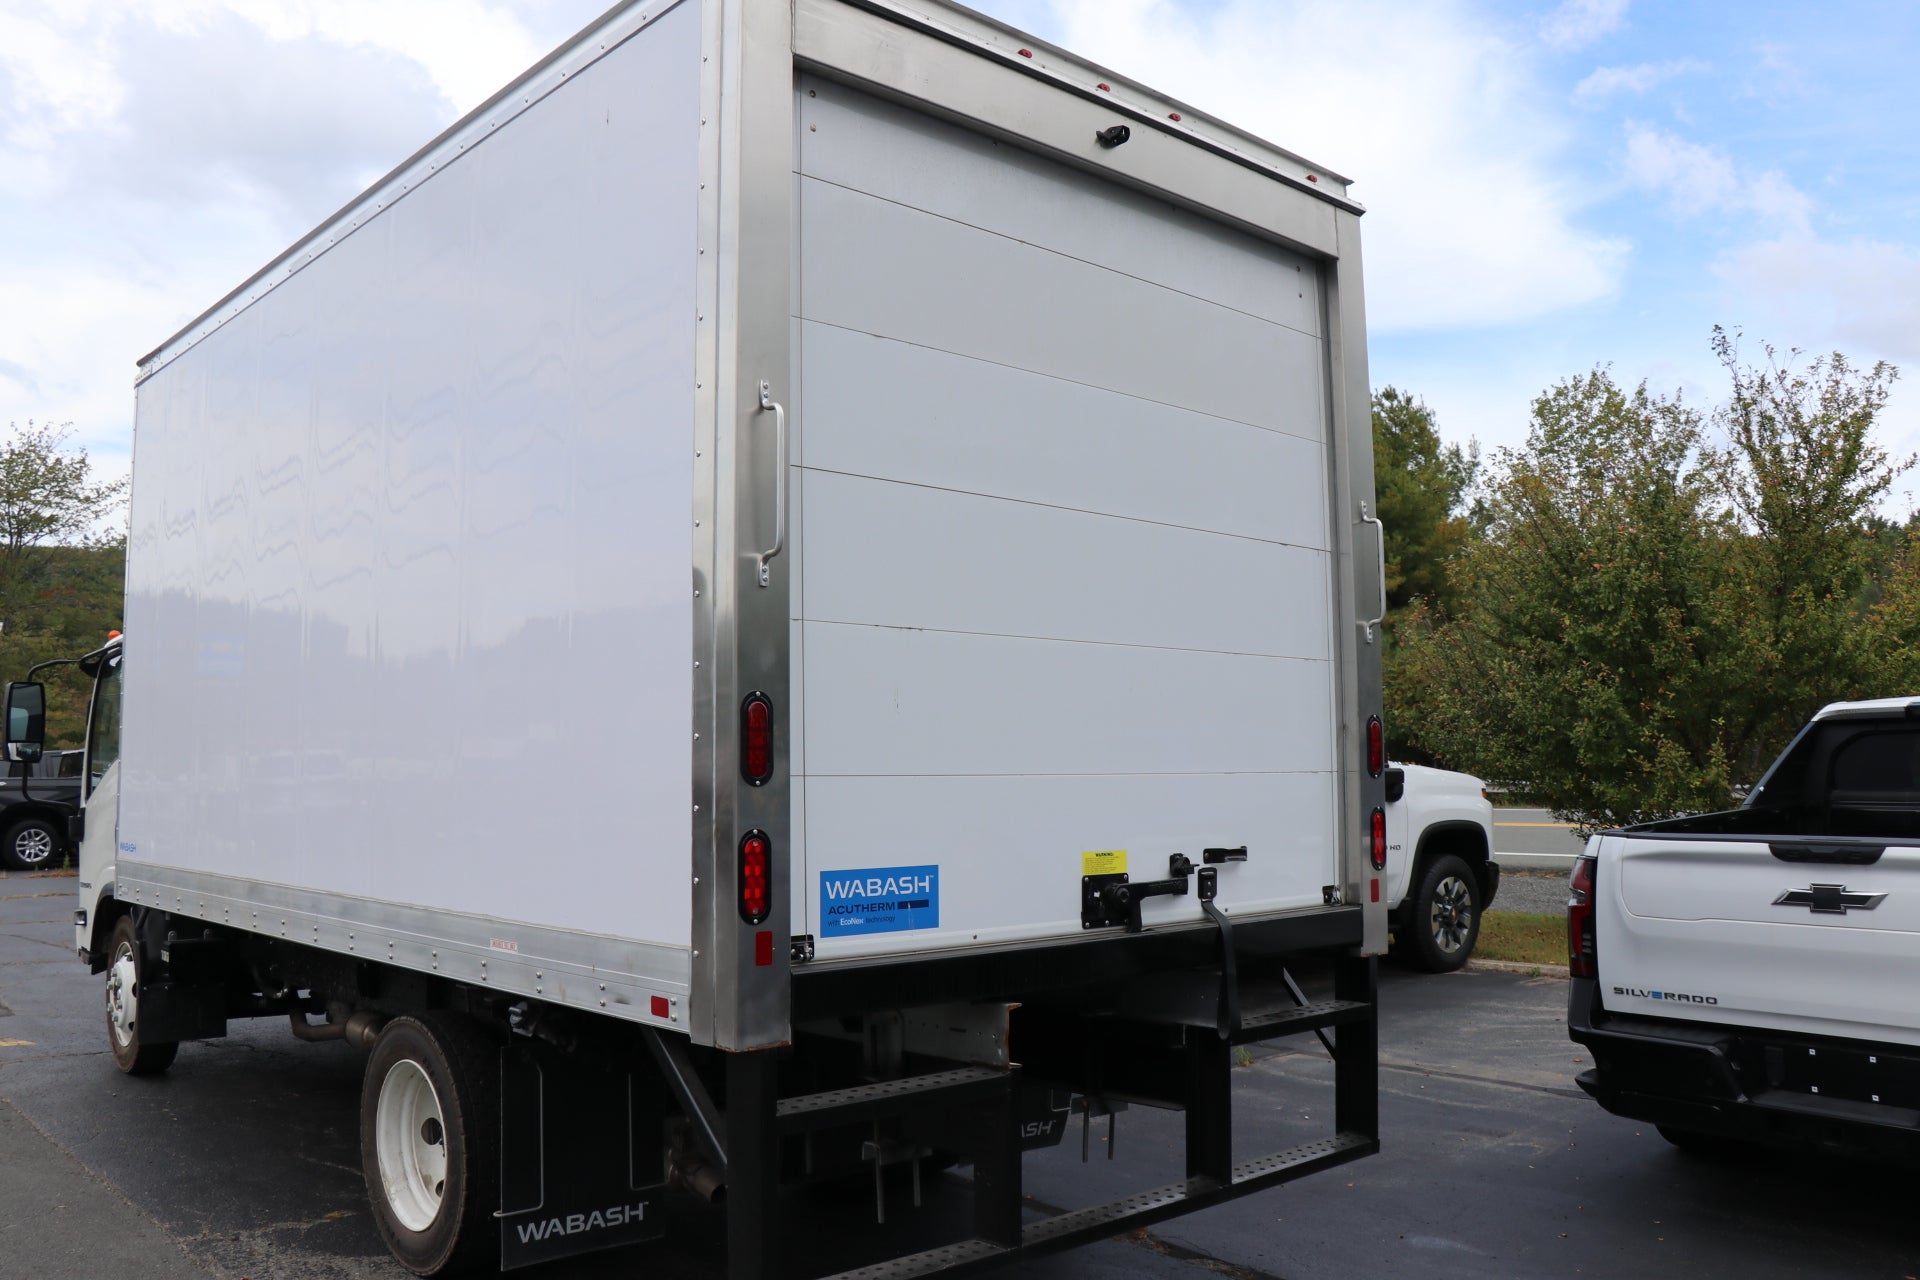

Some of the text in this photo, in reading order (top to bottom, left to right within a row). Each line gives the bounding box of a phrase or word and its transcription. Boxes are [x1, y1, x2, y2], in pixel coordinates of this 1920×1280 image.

[825, 875, 930, 899] WABASH
[828, 902, 896, 915] ACUTHERM
[1613, 986, 1718, 1005] SILVERADO
[517, 1202, 644, 1244] WABASH
